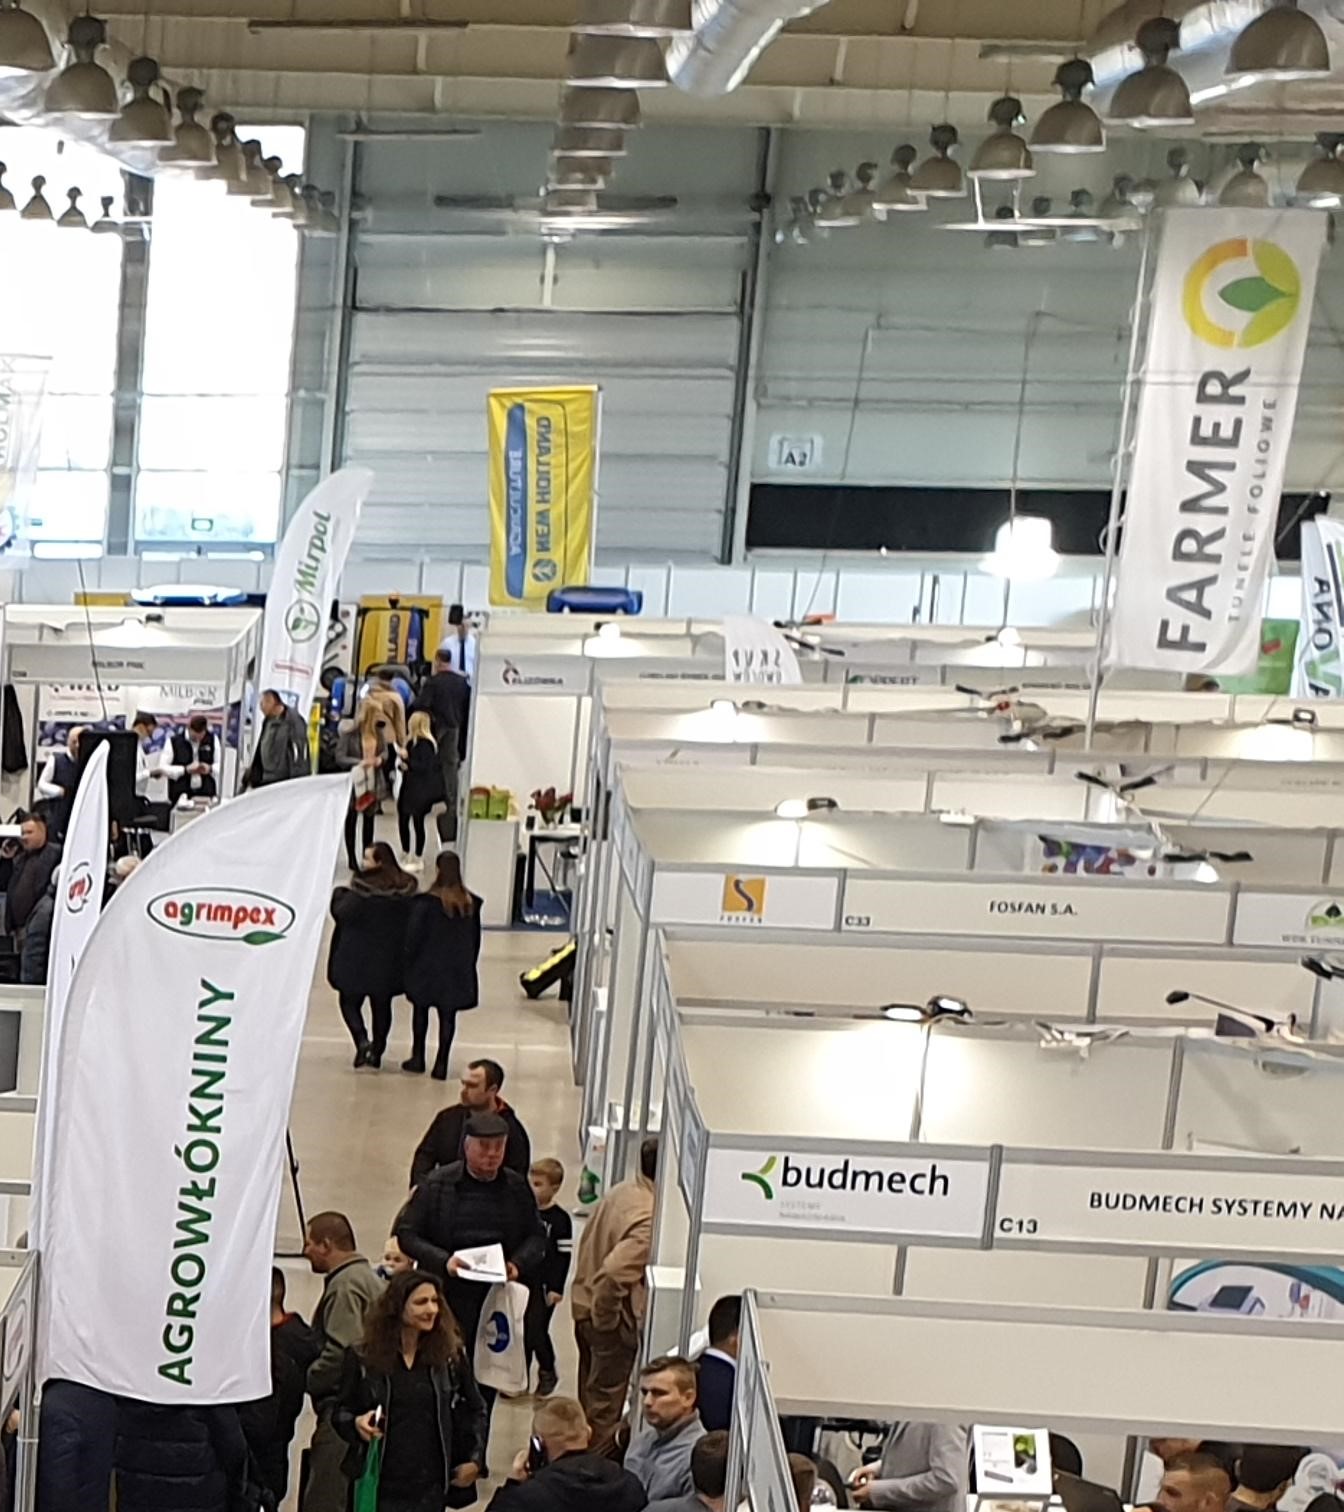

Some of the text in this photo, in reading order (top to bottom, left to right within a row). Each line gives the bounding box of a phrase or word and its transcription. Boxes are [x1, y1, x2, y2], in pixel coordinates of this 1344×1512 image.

[1156, 367, 1251, 653] FARMER
[1228, 398, 1277, 622] TUNELE FOLIOWE
[294, 510, 331, 594] Mirpol
[163, 900, 276, 931] agrimpex
[989, 901, 1078, 916] FOSFAN S.A.
[156, 978, 237, 1387] AGROWŁÓKNINY
[781, 1156, 949, 1196] budmech
[1089, 1191, 1204, 1214] BUDMECH
[1210, 1198, 1313, 1219] SYSTEMY
[999, 1218, 1038, 1234] C13
